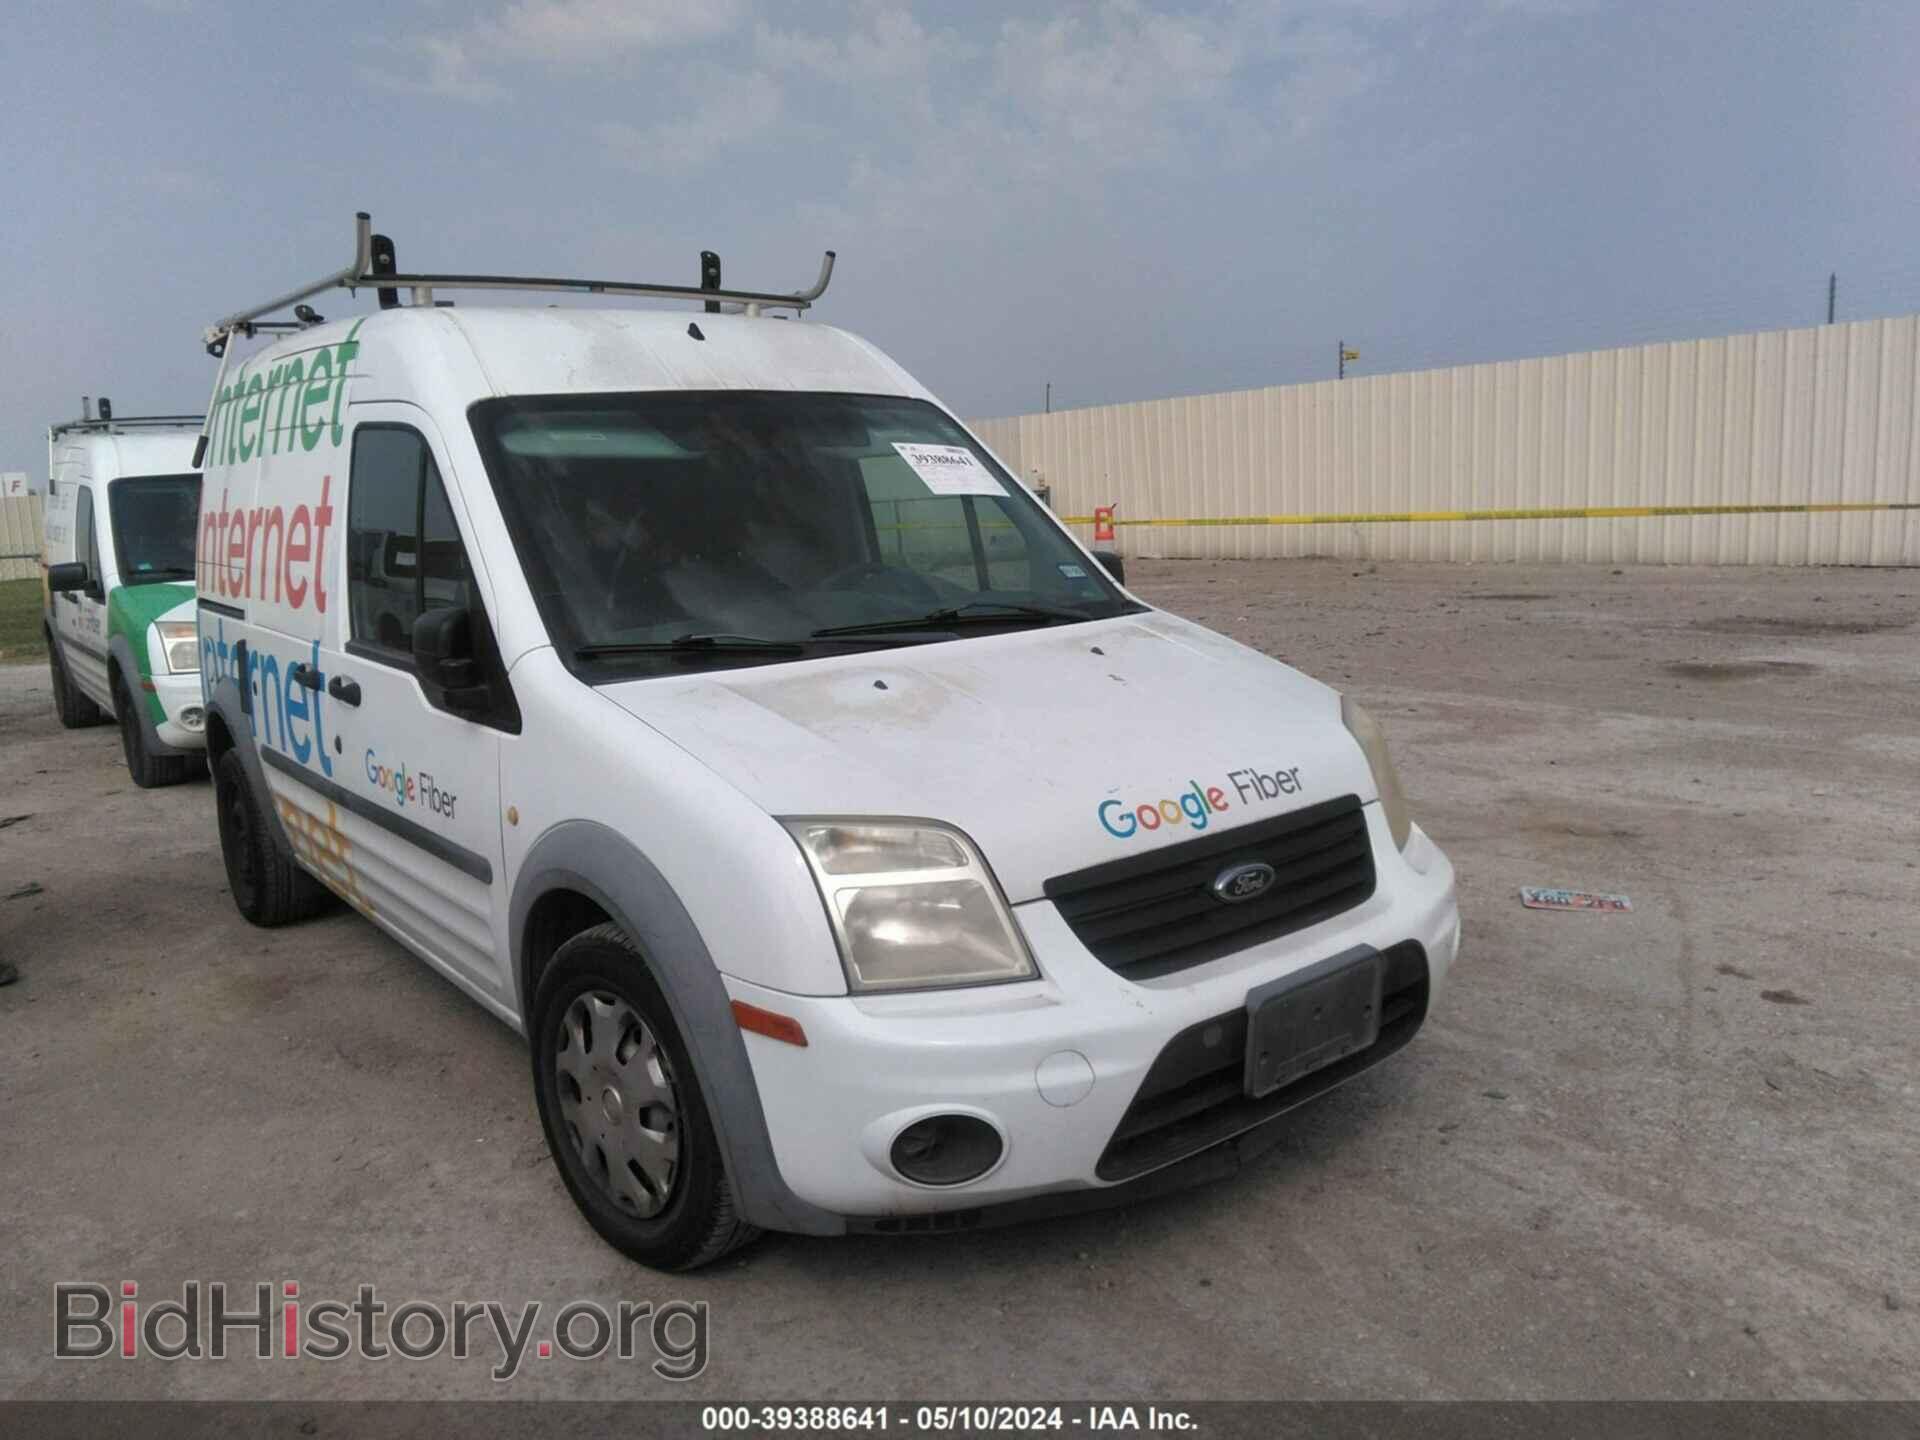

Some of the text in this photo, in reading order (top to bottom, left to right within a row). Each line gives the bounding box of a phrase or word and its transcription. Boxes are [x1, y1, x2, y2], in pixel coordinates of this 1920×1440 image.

[206, 317, 366, 468] nternet
[11, 480, 21, 492] F
[911, 454, 974, 466] 39388641
[365, 748, 457, 819] Google Fiber
[1098, 767, 1303, 838] Google Fiber
